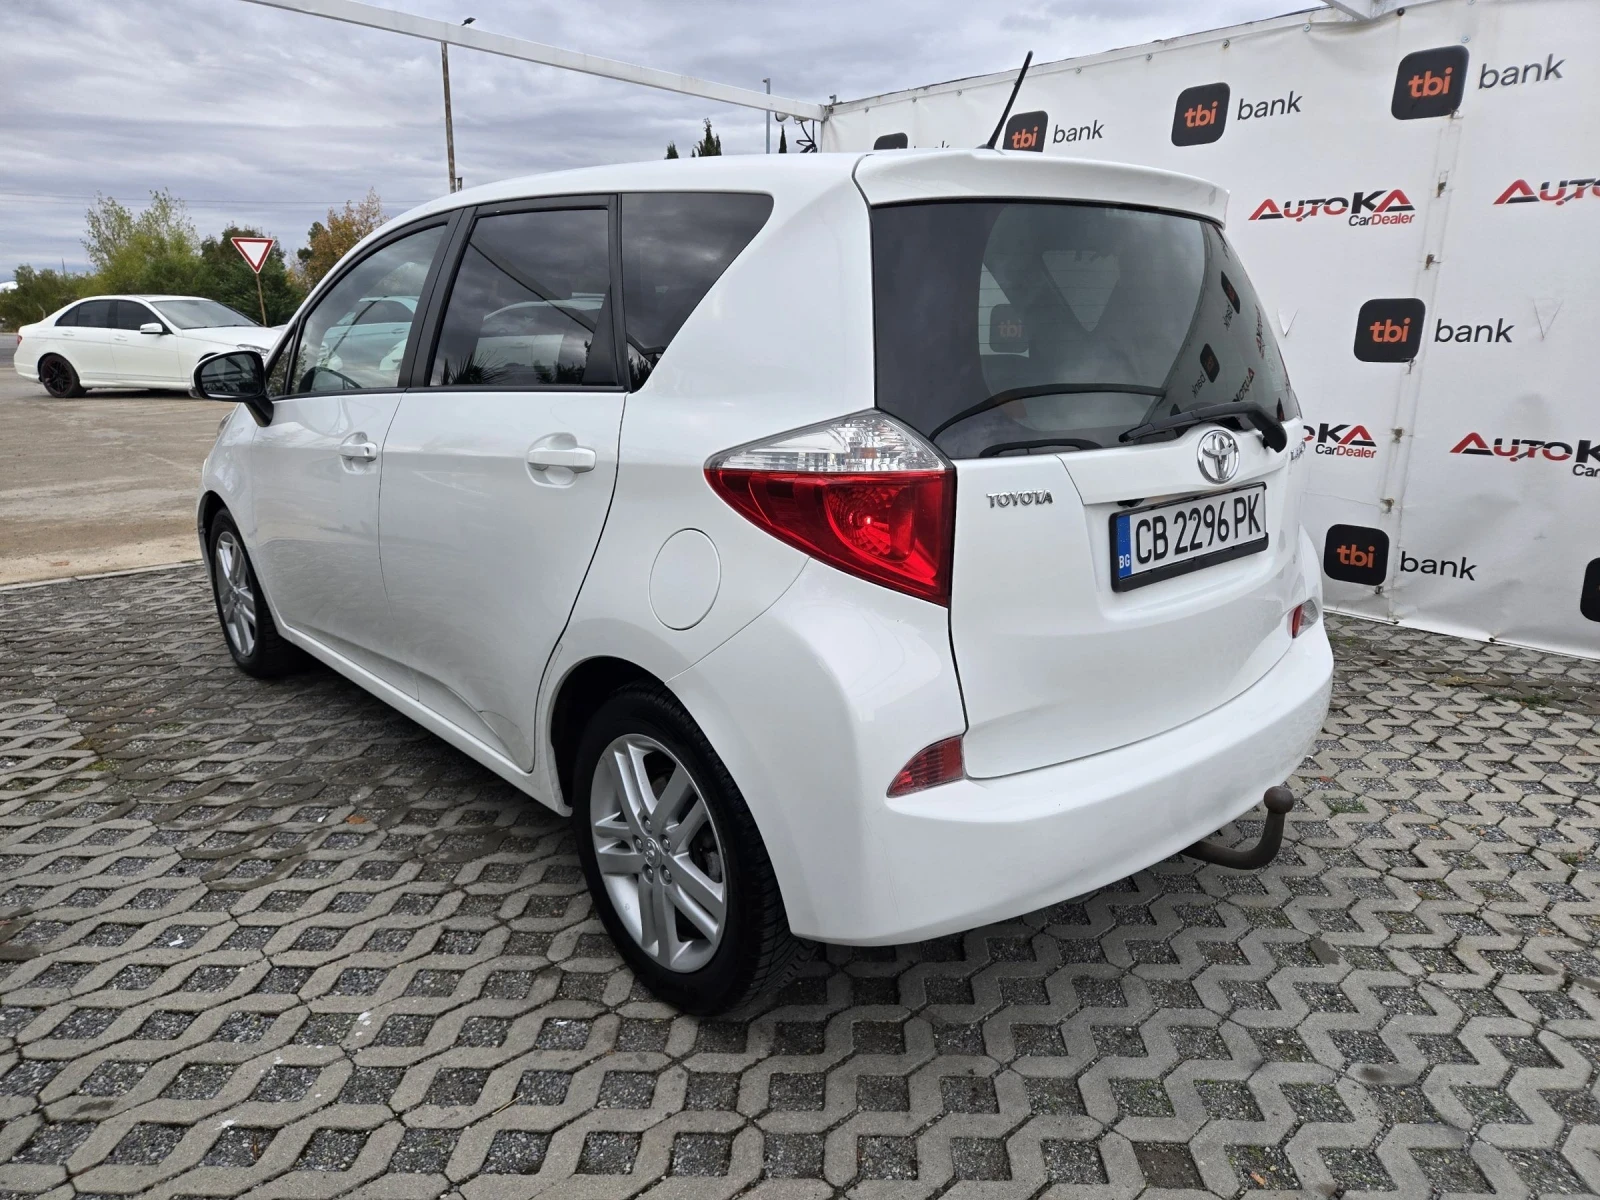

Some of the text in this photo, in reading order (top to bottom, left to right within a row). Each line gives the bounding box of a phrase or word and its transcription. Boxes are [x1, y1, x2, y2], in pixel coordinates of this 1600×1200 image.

[1408, 54, 1567, 98] tbi bank
[1184, 91, 1303, 128] tbi bank
[1012, 120, 1105, 149] tbi bank
[1492, 178, 1600, 206] AUT
[1348, 212, 1416, 227] CarDealer
[1369, 317, 1515, 343] tbi bank
[1315, 444, 1377, 458] CarDealer
[1449, 432, 1600, 463] AUTOK
[986, 489, 1053, 508] TOYOTA
[1135, 493, 1262, 564] CB 2296 PK
[1118, 554, 1131, 569] BG
[1336, 544, 1478, 581] tbi bank
